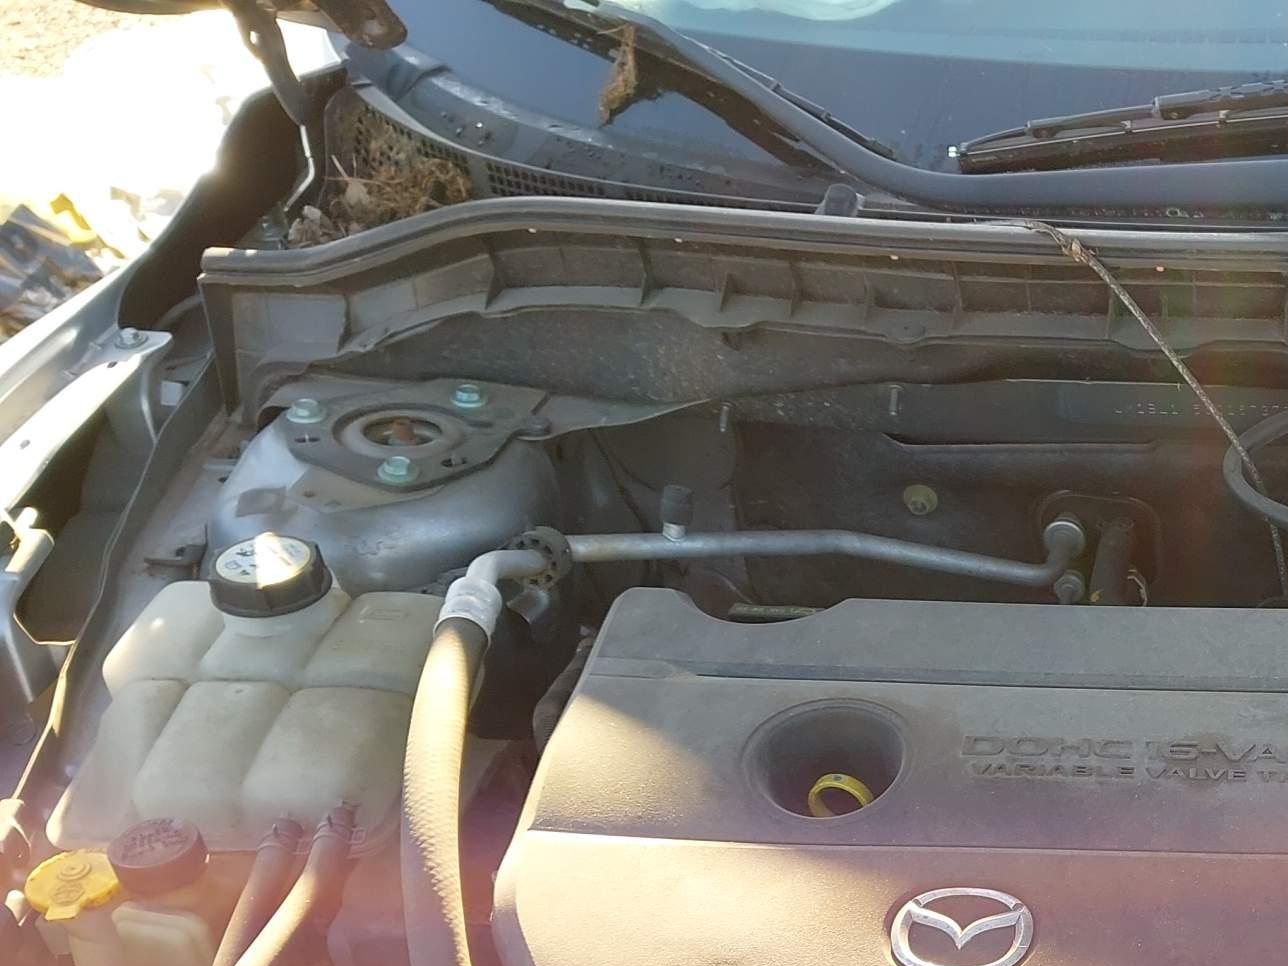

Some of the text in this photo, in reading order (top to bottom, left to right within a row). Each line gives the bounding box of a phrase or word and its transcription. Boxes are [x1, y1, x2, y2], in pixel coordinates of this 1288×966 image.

[960, 735, 1133, 760] DOHC
[972, 762, 1135, 779] VARIABLE
[1146, 765, 1247, 783] VALVE
